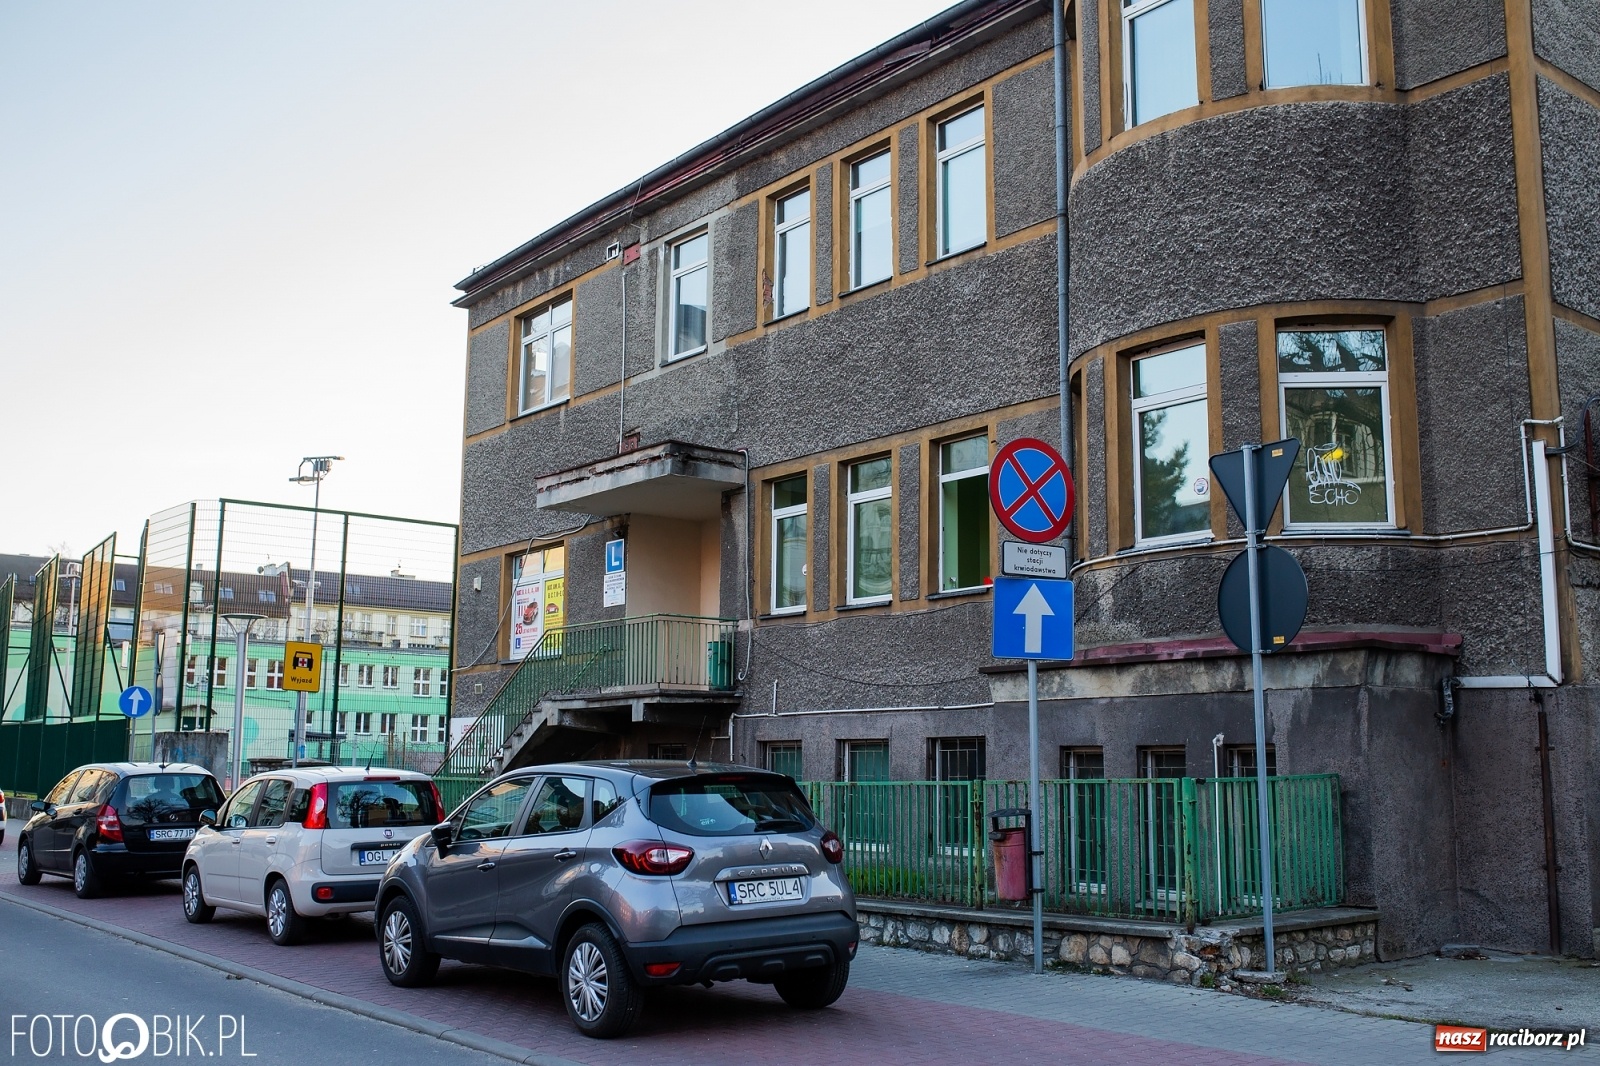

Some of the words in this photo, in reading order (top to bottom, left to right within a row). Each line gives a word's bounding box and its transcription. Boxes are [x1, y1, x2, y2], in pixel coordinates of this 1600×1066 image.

[1309, 488, 1359, 506] ECHO
[611, 546, 620, 567] L
[1029, 548, 1052, 557] dotyczy
[1026, 557, 1044, 566] stacji
[1013, 564, 1056, 574] krwiodawstwa
[515, 623, 523, 635] 25
[291, 676, 312, 684] Wyjazd
[155, 830, 173, 839] SRC
[366, 851, 388, 862] OGL
[737, 866, 798, 877] CAPTUR
[737, 882, 766, 899] SRC
[768, 879, 799, 896] 5UL4
